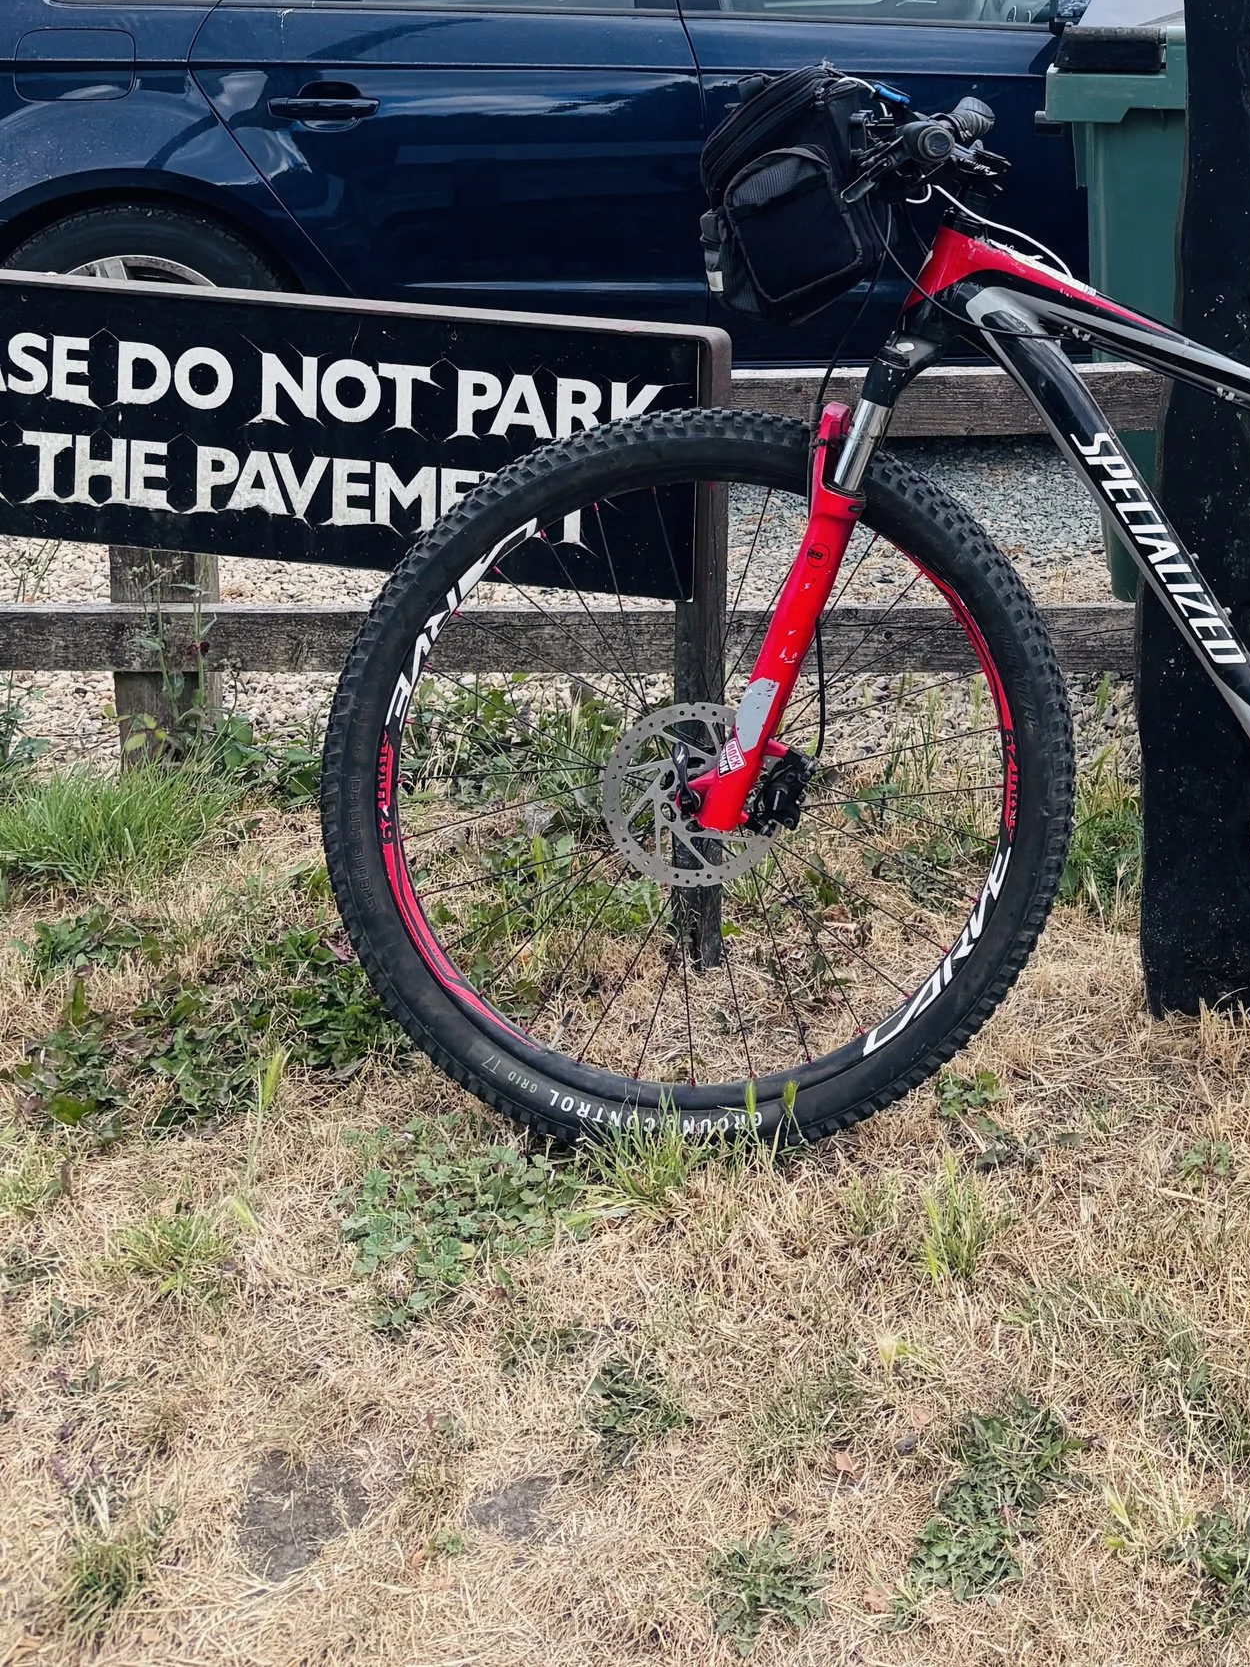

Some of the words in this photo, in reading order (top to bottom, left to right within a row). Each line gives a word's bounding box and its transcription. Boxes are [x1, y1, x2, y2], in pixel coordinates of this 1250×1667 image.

[0, 331, 97, 409] SE
[117, 340, 234, 411] DO
[255, 349, 448, 432] NOT
[21, 430, 170, 512] THE
[1070, 432, 1248, 665] SPECIALIZED
[726, 742, 742, 768] ROCK
[862, 840, 1013, 1058] CARVE
[481, 1054, 502, 1075] T7
[507, 1070, 538, 1095] GRID
